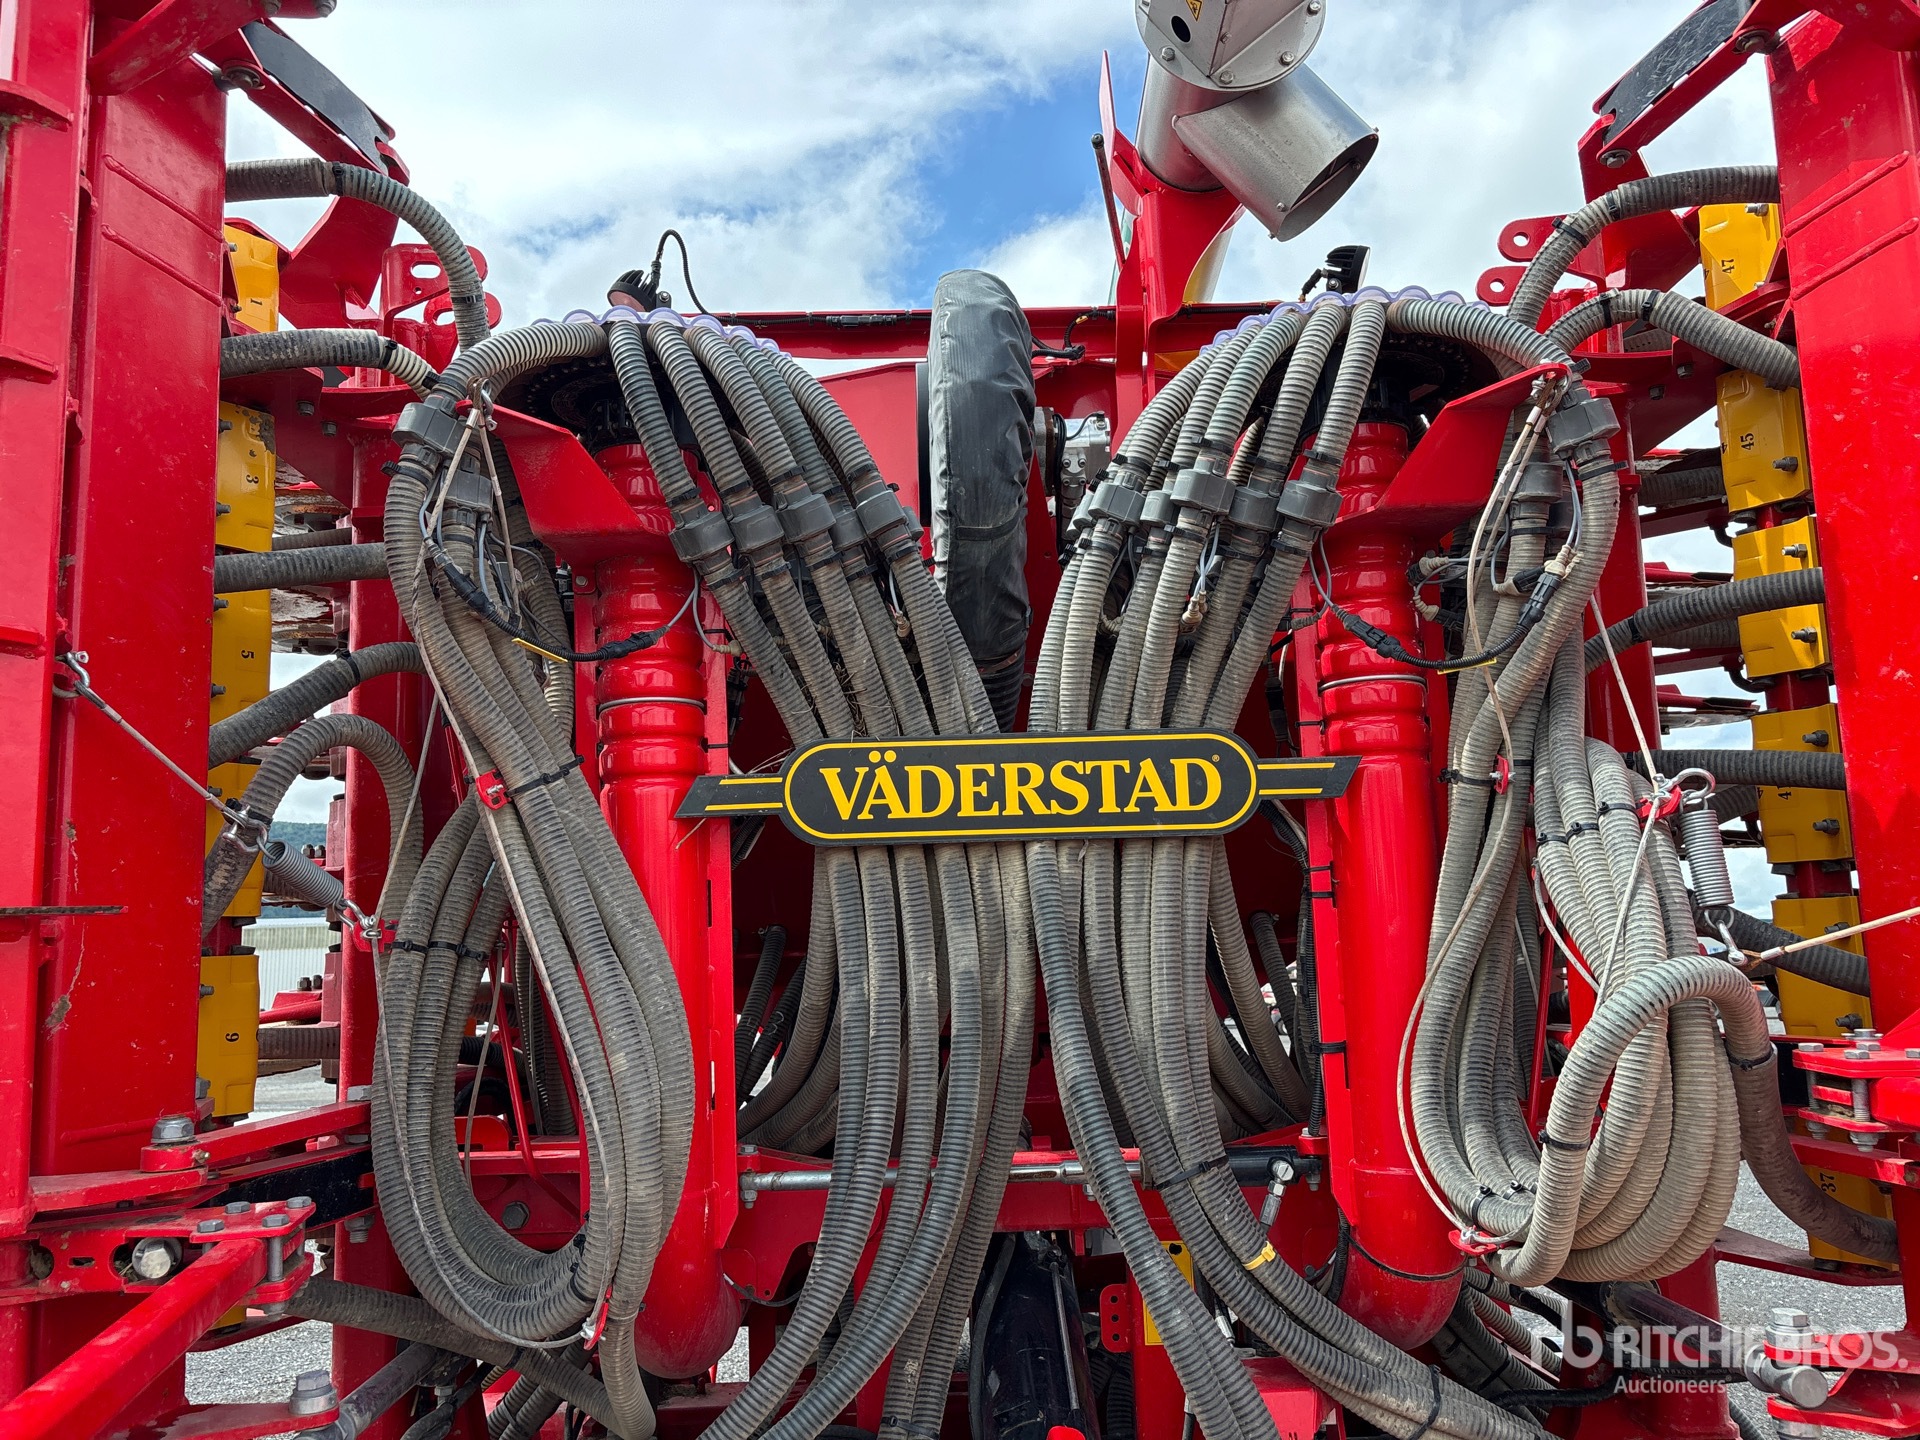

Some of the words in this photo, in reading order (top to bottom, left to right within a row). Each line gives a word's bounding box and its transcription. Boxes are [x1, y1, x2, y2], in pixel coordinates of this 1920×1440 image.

[1721, 258, 1735, 274] 47
[250, 298, 263, 306] 1
[1739, 432, 1755, 451] 45
[245, 474, 260, 484] 3
[240, 649, 255, 659] 5
[819, 749, 1222, 821] VÄDERSTAD
[225, 1032, 240, 1043] 9
[1819, 1172, 1837, 1193] 37
